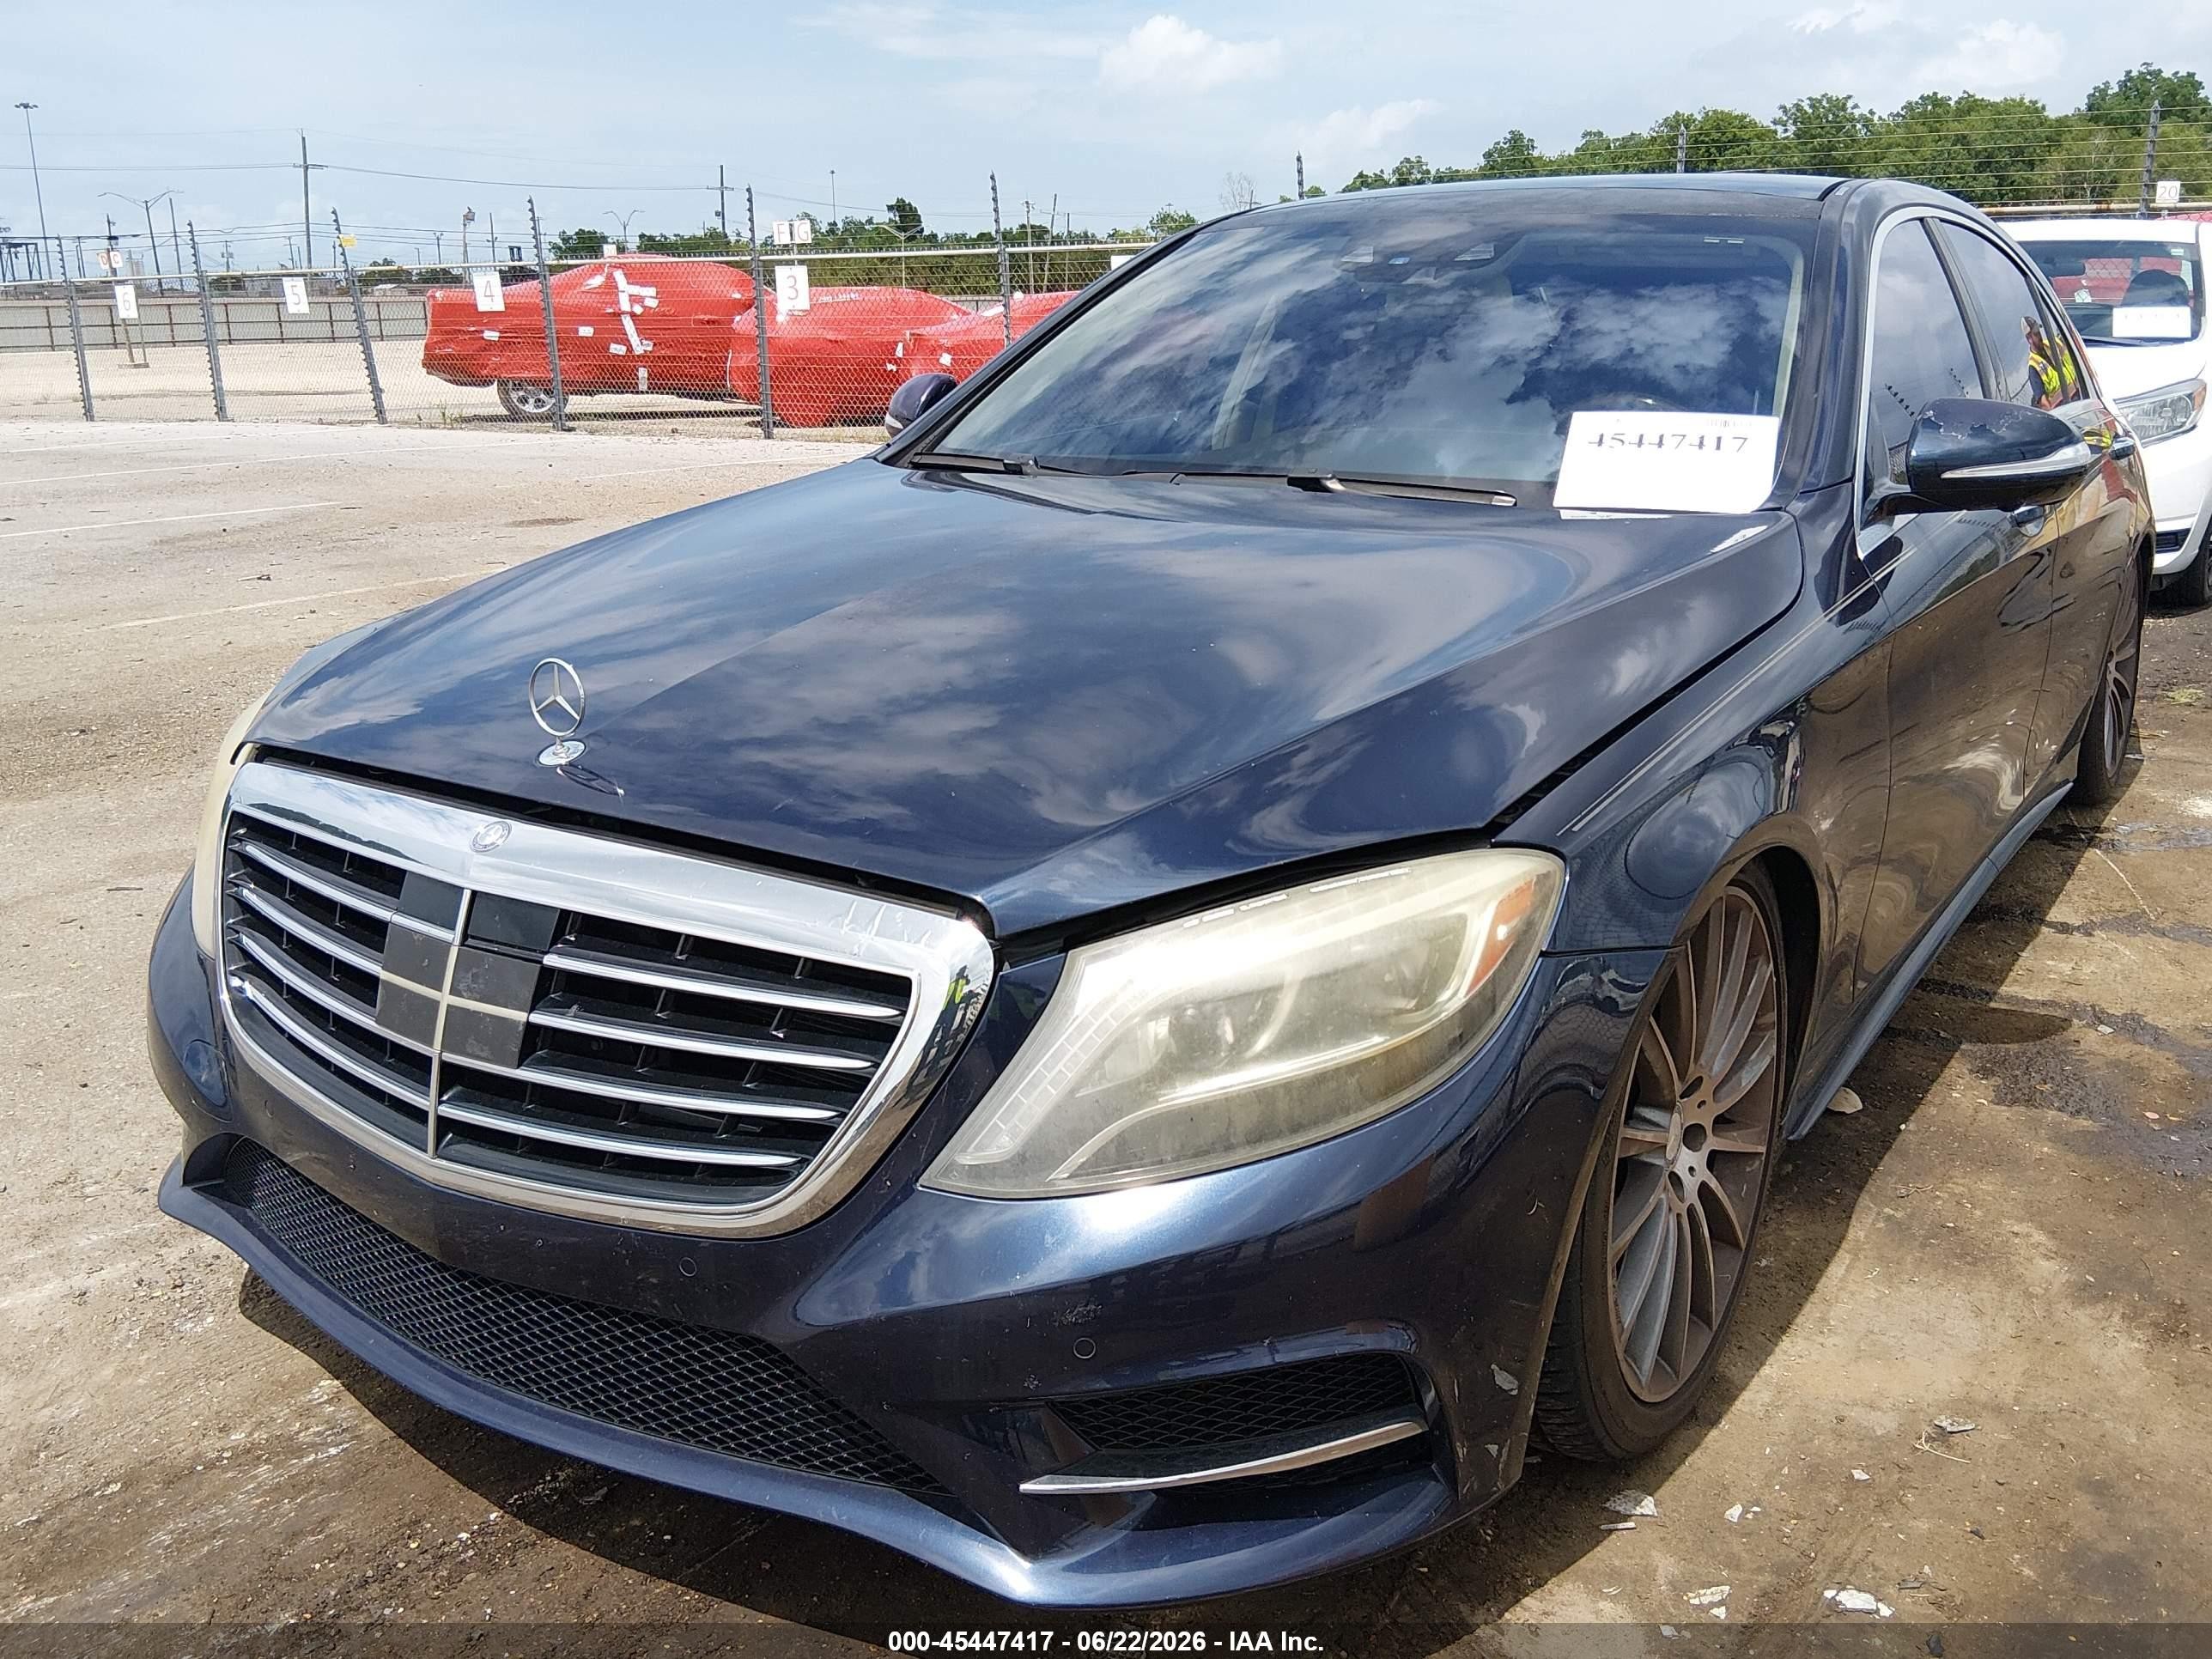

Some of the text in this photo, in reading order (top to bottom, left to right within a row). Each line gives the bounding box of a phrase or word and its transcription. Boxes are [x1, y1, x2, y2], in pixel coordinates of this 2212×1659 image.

[2158, 185, 2178, 198] 20
[776, 223, 785, 242] F
[797, 222, 809, 241] G
[112, 253, 119, 264] C
[290, 284, 301, 305] 5
[483, 280, 495, 302] 4
[786, 275, 799, 300] 3
[123, 292, 131, 311] 6
[1588, 432, 1748, 453] 45447417
